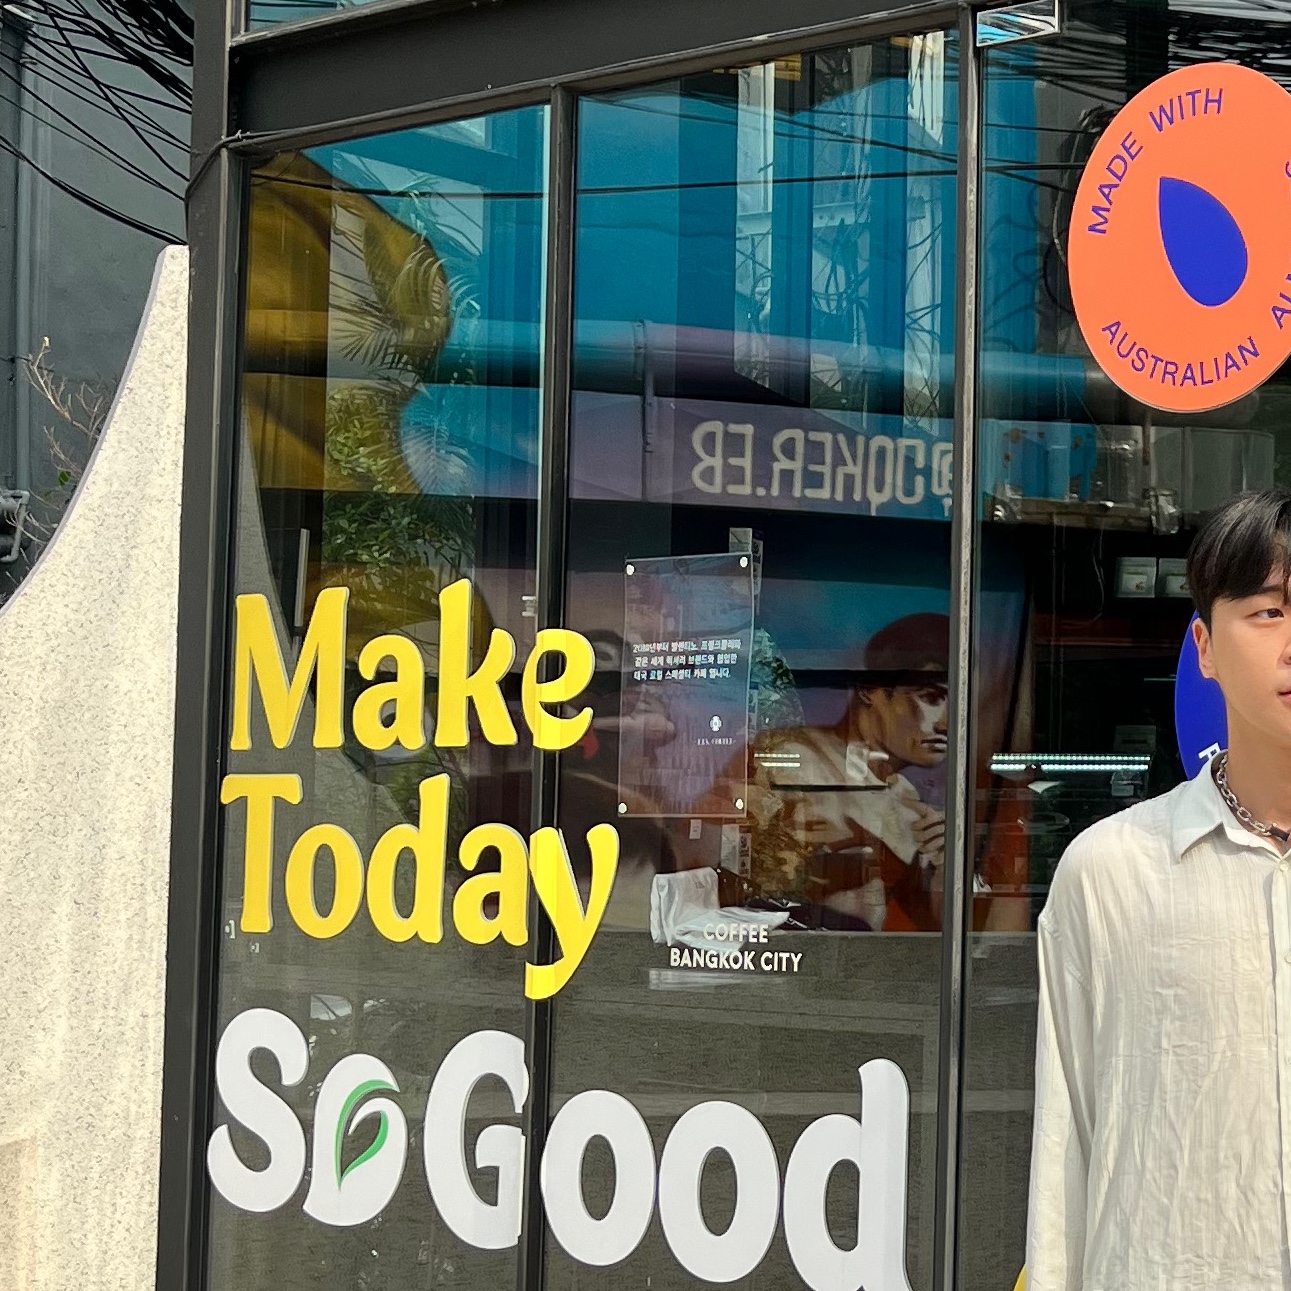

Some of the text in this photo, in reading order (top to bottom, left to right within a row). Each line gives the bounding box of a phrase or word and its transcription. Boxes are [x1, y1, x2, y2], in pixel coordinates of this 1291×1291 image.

[1087, 87, 1224, 235] MADE WITH
[1101, 319, 1261, 388] AUSTRALIAN
[230, 577, 596, 752] Make
[220, 772, 621, 1001] Today
[670, 946, 803, 972] BANGKOK CITY
[703, 922, 769, 944] COFFEE
[207, 1008, 407, 1227] So
